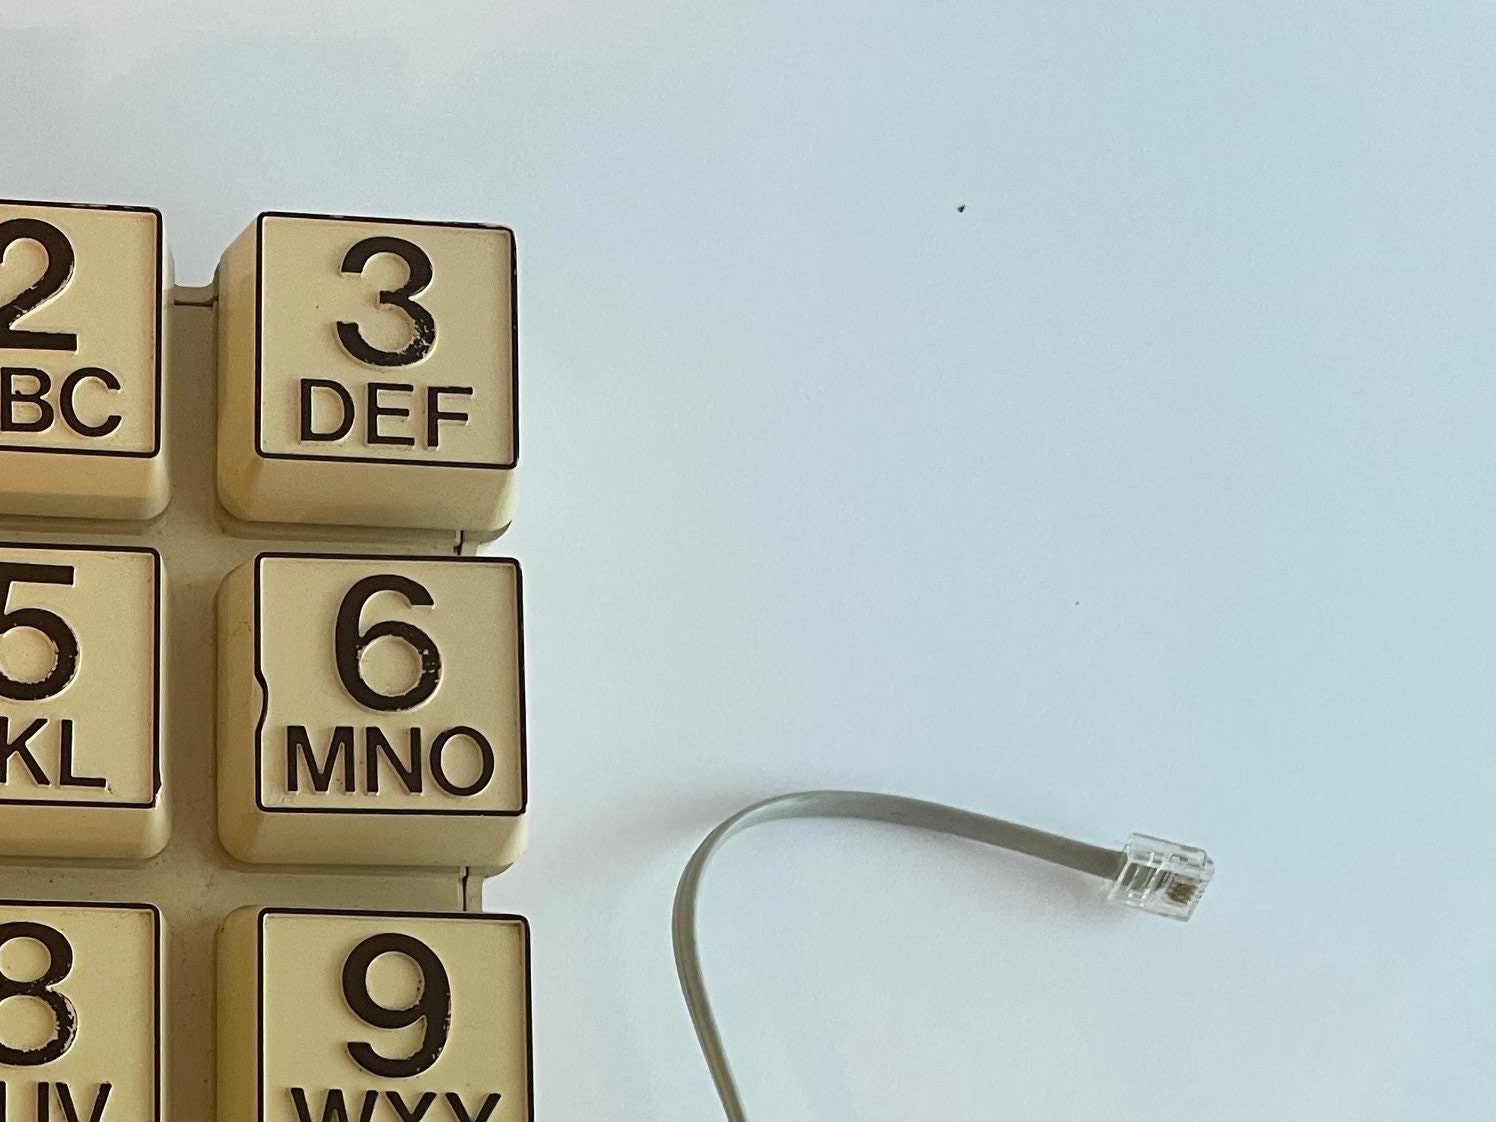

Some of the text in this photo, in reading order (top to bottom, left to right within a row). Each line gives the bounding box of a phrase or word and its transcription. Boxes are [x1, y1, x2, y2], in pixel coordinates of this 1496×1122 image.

[336, 236, 435, 366] 3
[300, 378, 473, 447] DEF
[335, 574, 441, 712] 6
[287, 725, 494, 796] MNO
[342, 933, 451, 1078] 9
